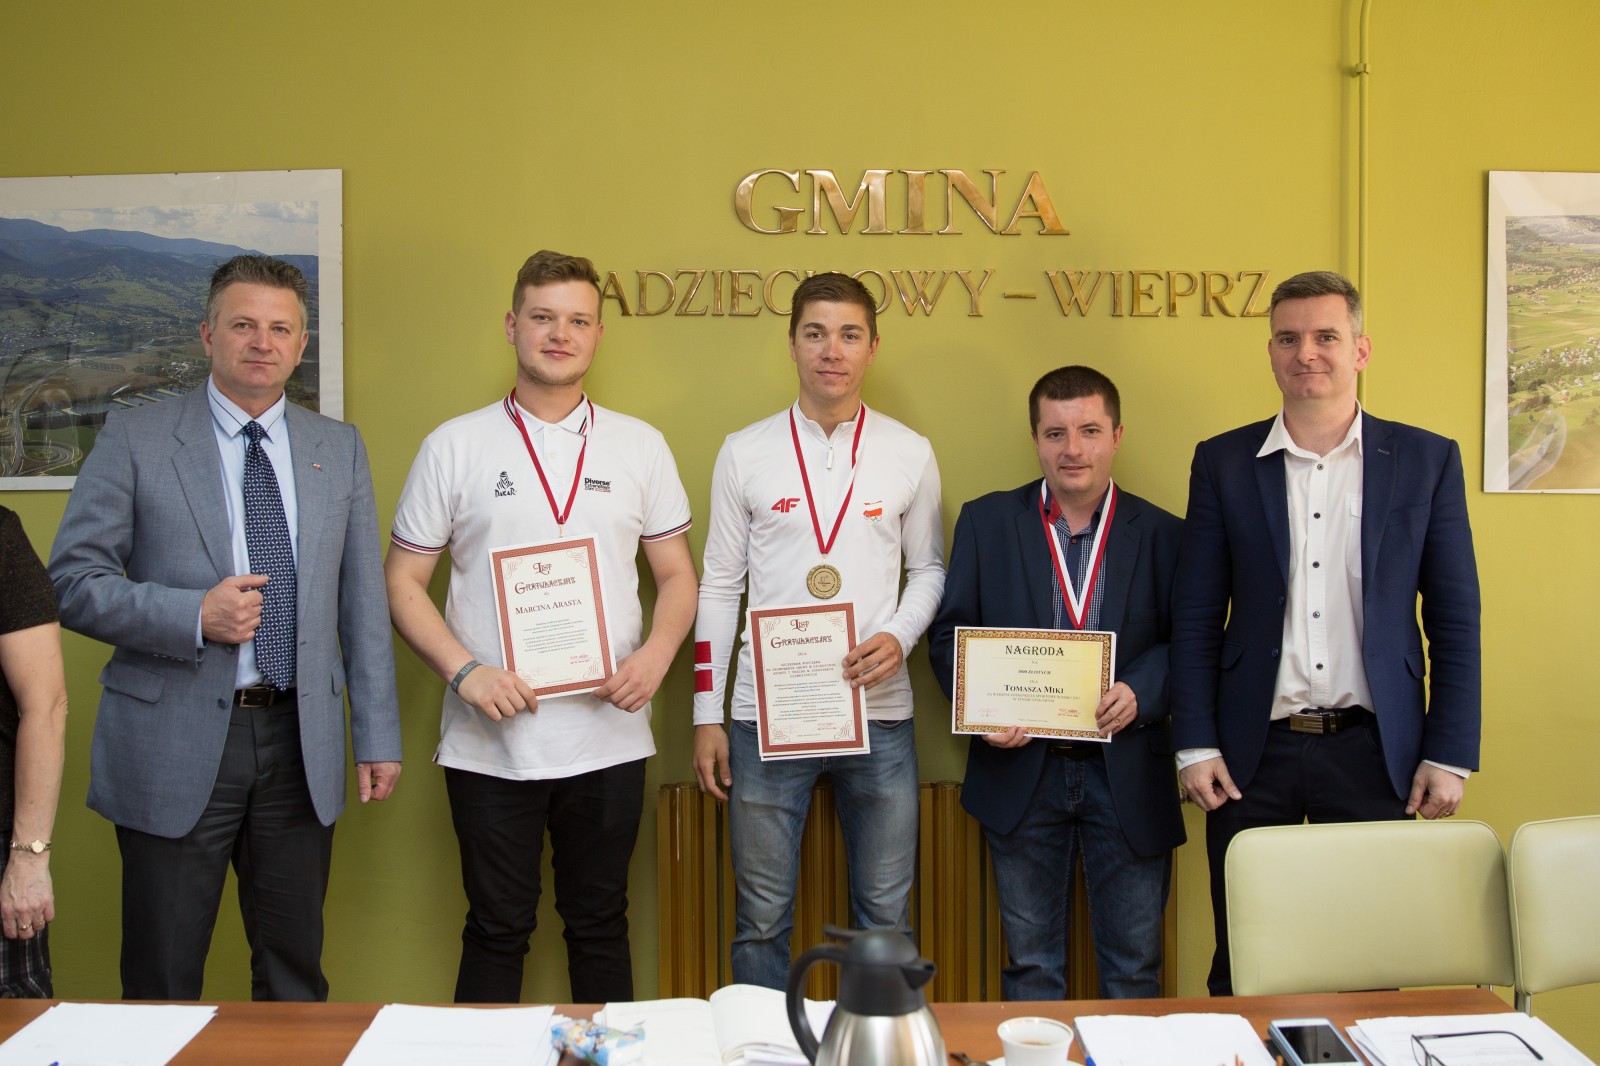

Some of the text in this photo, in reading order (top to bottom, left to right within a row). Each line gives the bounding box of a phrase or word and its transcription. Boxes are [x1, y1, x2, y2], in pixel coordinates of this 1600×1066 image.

[734, 169, 1070, 235] GMINA
[601, 269, 995, 317] ADZIECOWY
[1044, 269, 1272, 317] WIEPRZ
[584, 477, 611, 486] Diverse
[771, 498, 801, 513] 4F
[515, 598, 582, 615] MARCINA ARASTA
[1005, 645, 1065, 657] NAGRODA
[1004, 684, 1064, 694] TOMASZA MIKI
